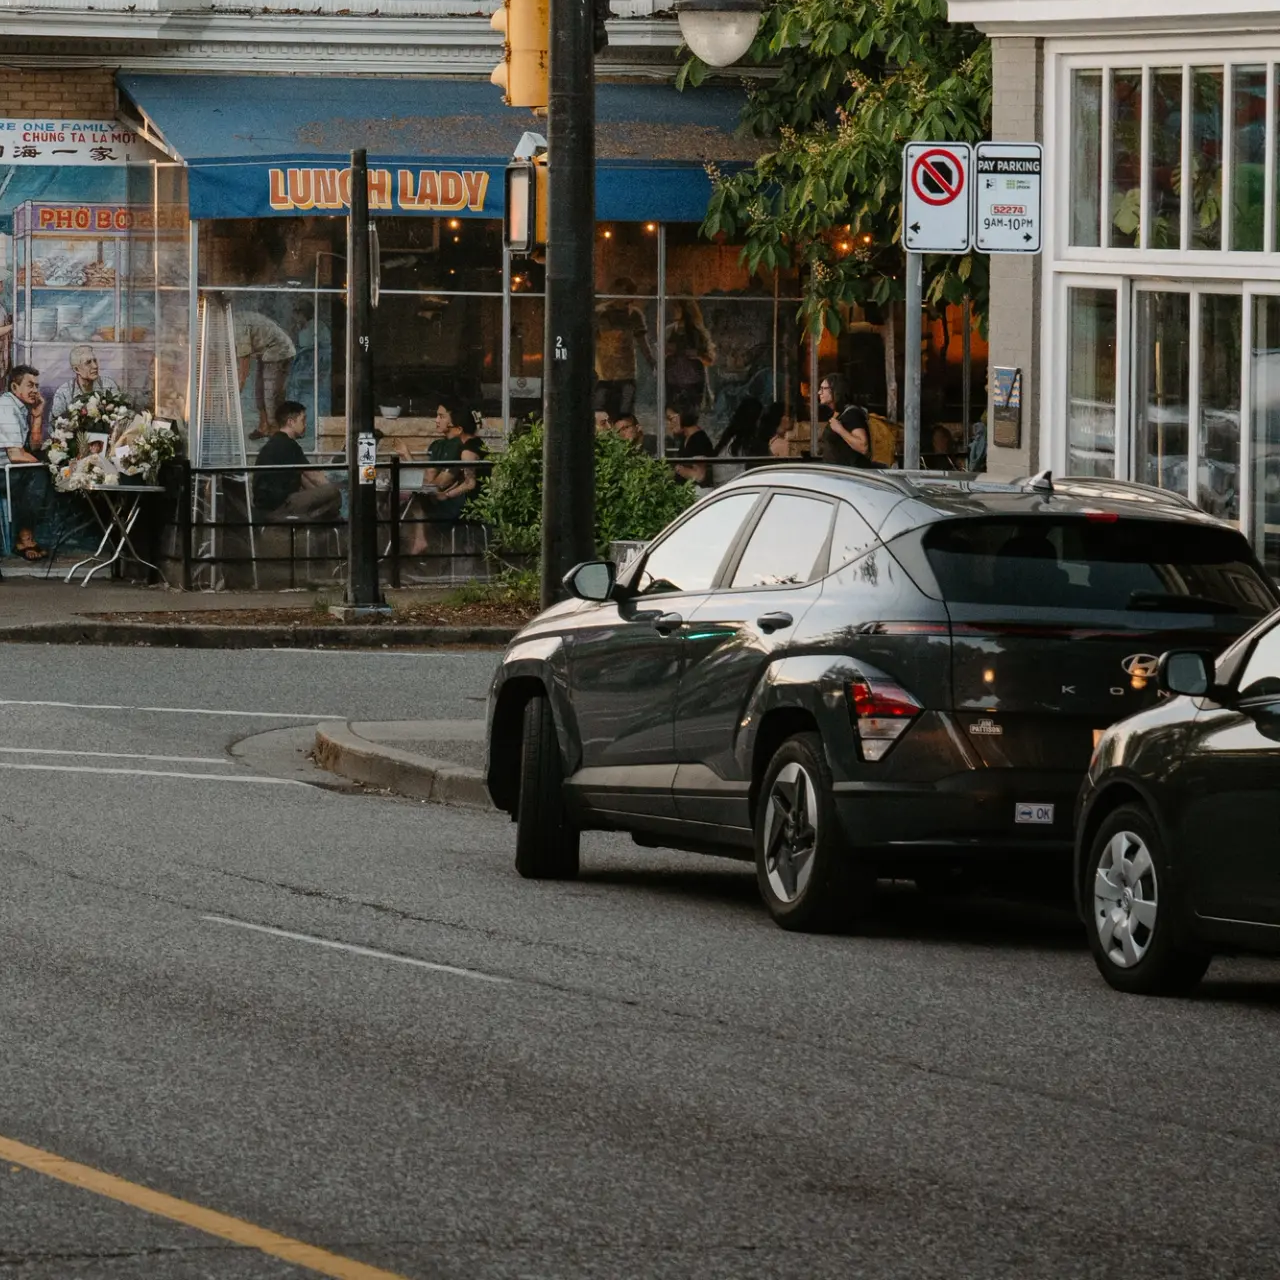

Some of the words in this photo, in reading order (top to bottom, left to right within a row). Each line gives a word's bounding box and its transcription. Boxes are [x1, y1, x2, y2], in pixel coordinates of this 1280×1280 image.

[23, 122, 54, 132] ONE
[60, 123, 118, 133] FAMILY
[71, 132, 86, 143] TA
[978, 161, 995, 171] PAY
[997, 161, 1040, 172] PARKING
[398, 170, 489, 211] LADY
[556, 335, 563, 348] 2
[1061, 685, 1170, 698] KON
[1036, 808, 1051, 819] OK
